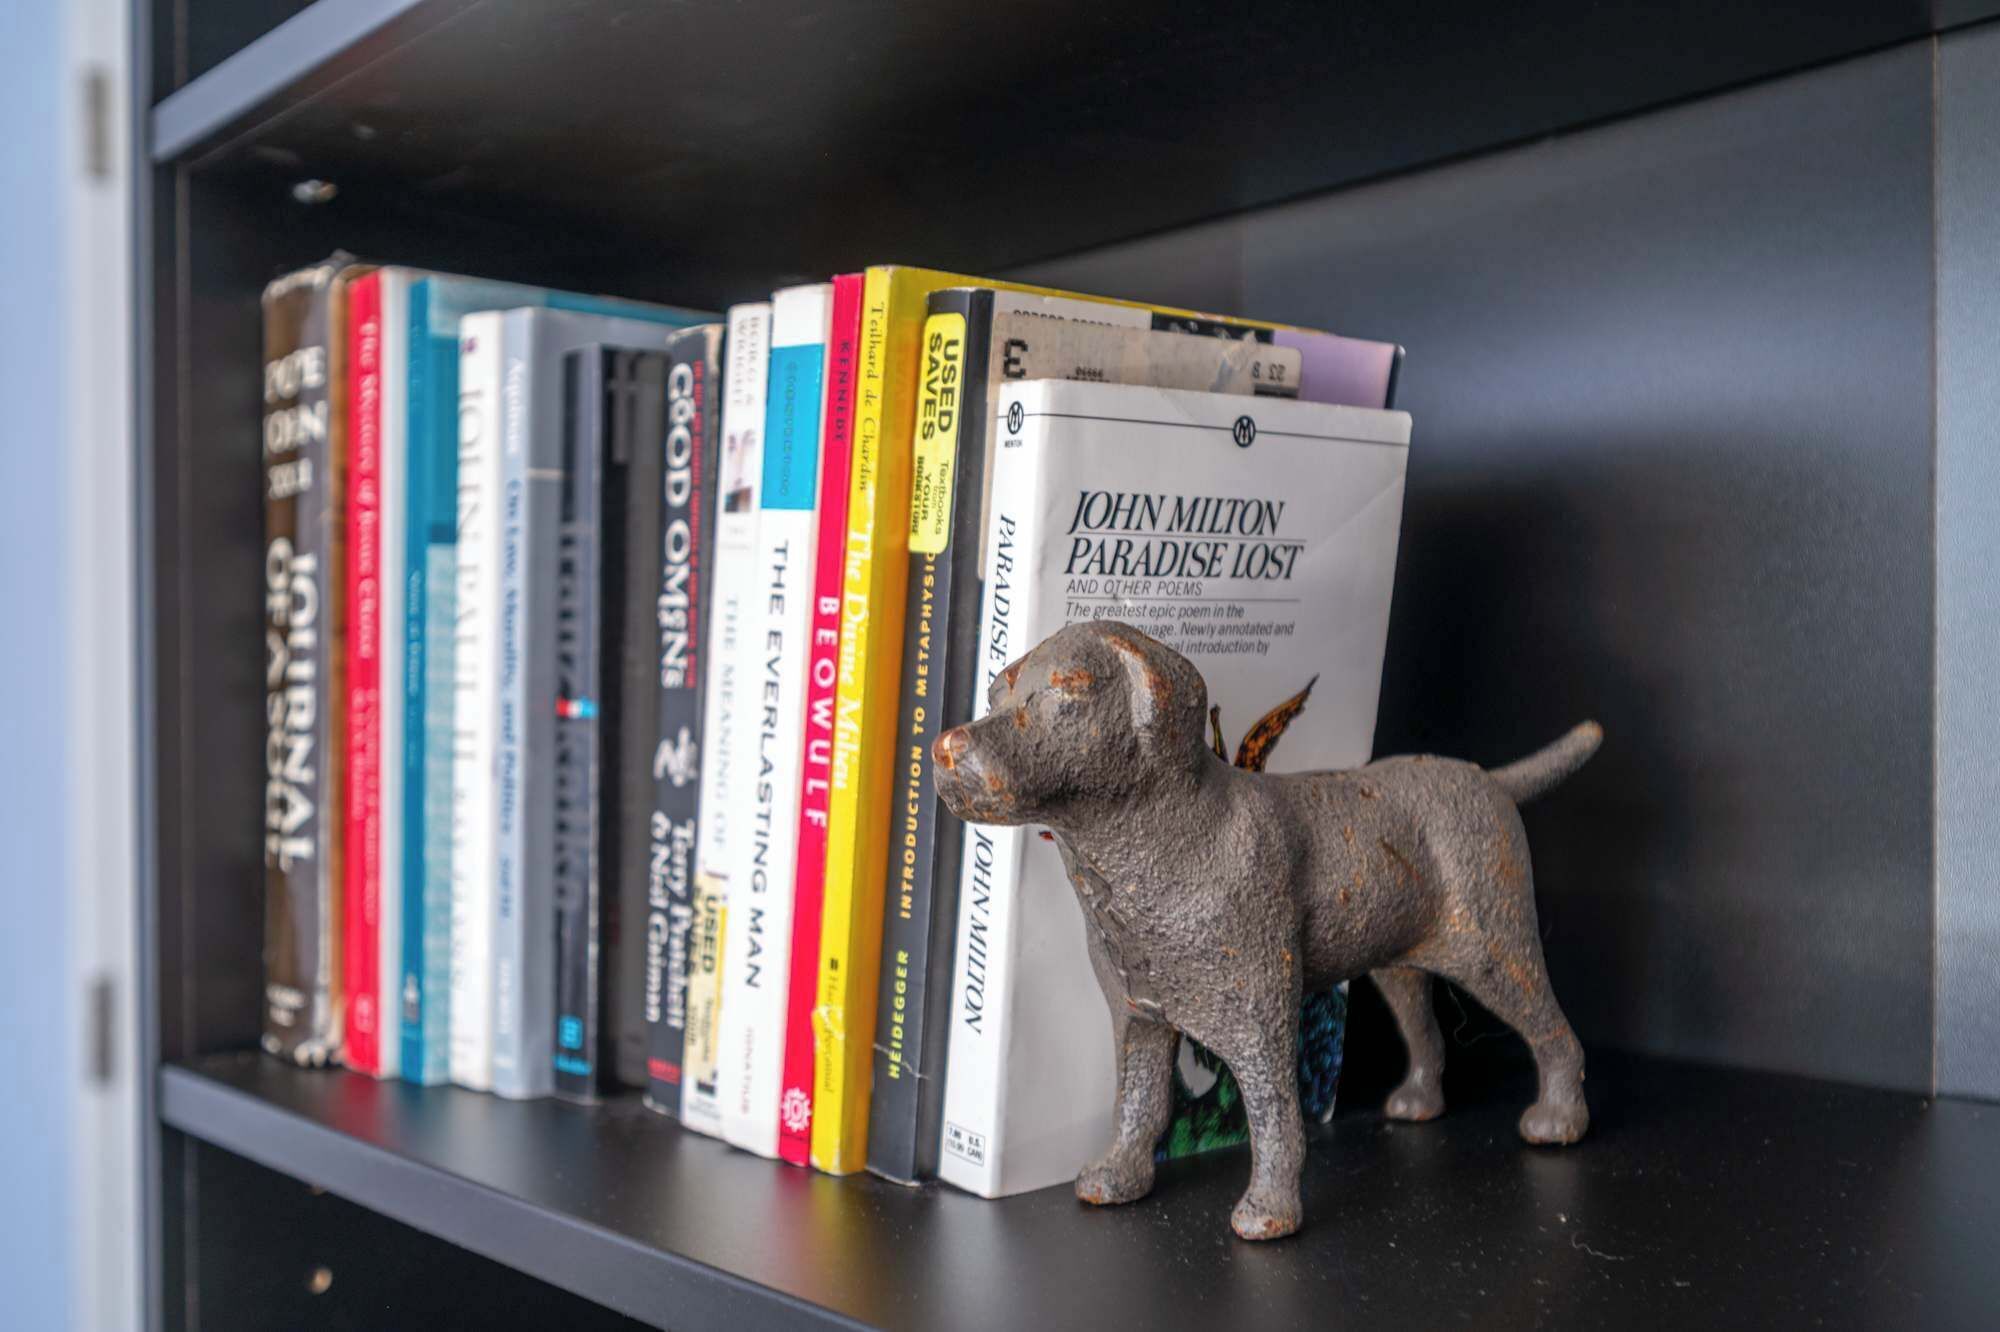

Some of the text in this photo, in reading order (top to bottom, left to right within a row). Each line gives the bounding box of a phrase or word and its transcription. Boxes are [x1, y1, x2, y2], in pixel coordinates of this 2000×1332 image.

[858, 302, 885, 492] Teilhard de Chardin
[921, 331, 943, 441] SAVES
[938, 339, 959, 433] USED
[664, 363, 695, 507] GOOD
[911, 455, 925, 536] BOOKSTORE
[920, 472, 931, 521] YOUR
[935, 458, 949, 535] Textbooks
[1067, 490, 1285, 536] JOHN MILTON
[990, 514, 1016, 662] PARADISE
[1064, 537, 1304, 580] PARADISE LOST
[1066, 580, 1203, 597] AND OTHER POEMS
[834, 521, 874, 790] The Divine Milieu
[1066, 602, 1245, 623] The greatest epic poem in the
[1180, 622, 1216, 638] Newly
[1218, 621, 1274, 636] annotated
[1275, 621, 1295, 636] and
[1186, 640, 1255, 655] introduction
[1256, 642, 1271, 657] by
[280, 552, 319, 872] JOURNAL
[803, 595, 840, 828] BEOWULF
[899, 552, 937, 919] INTRODUCTION TO METAPHYSIC
[746, 539, 789, 988] THE EVERLASTING MAN
[649, 843, 671, 908] Neil
[666, 819, 695, 898] Terry
[702, 894, 718, 975] USED
[965, 828, 994, 1034] JOHN MILTON
[888, 951, 909, 1079] HEIDEGGER
